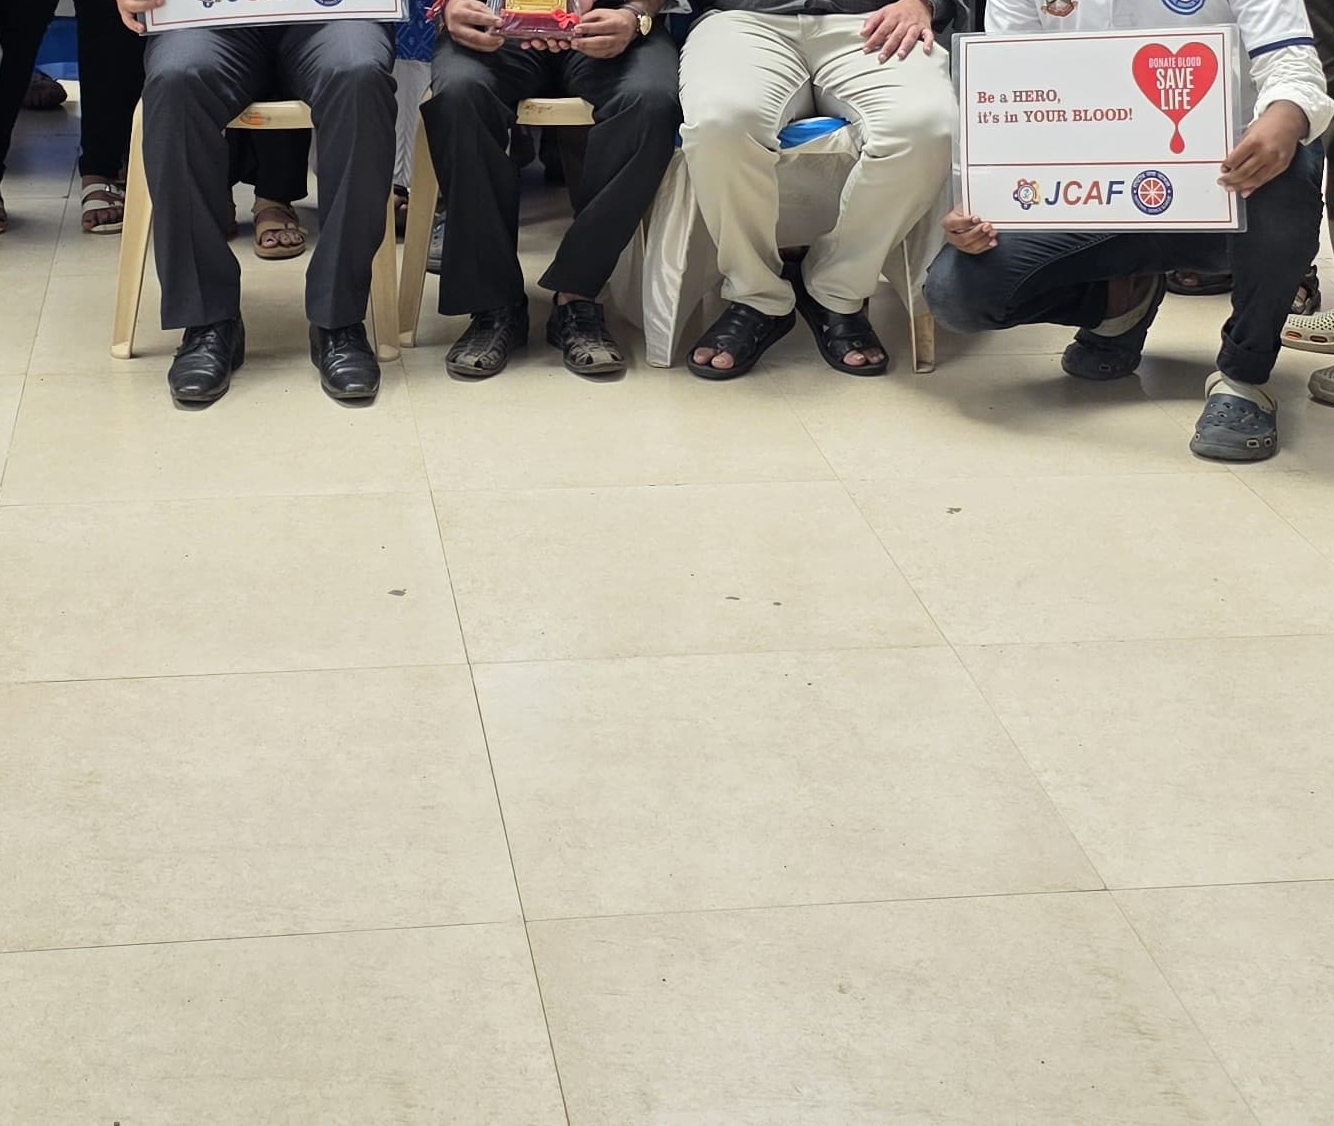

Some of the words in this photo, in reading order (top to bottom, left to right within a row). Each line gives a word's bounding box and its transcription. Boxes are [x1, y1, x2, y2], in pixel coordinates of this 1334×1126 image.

[1148, 57, 1177, 68] DONATE
[1177, 56, 1202, 68] BLOOD
[1156, 68, 1194, 90] SAVE
[977, 91, 995, 104] Be
[999, 93, 1008, 103] a
[1012, 89, 1061, 104] HERO,
[1160, 89, 1191, 111] LIFE
[977, 111, 1000, 124] it's
[1004, 111, 1018, 123] in
[1023, 109, 1068, 123] YOUR
[1072, 107, 1134, 122] BLOOD!
[1044, 180, 1125, 206] JCAF
